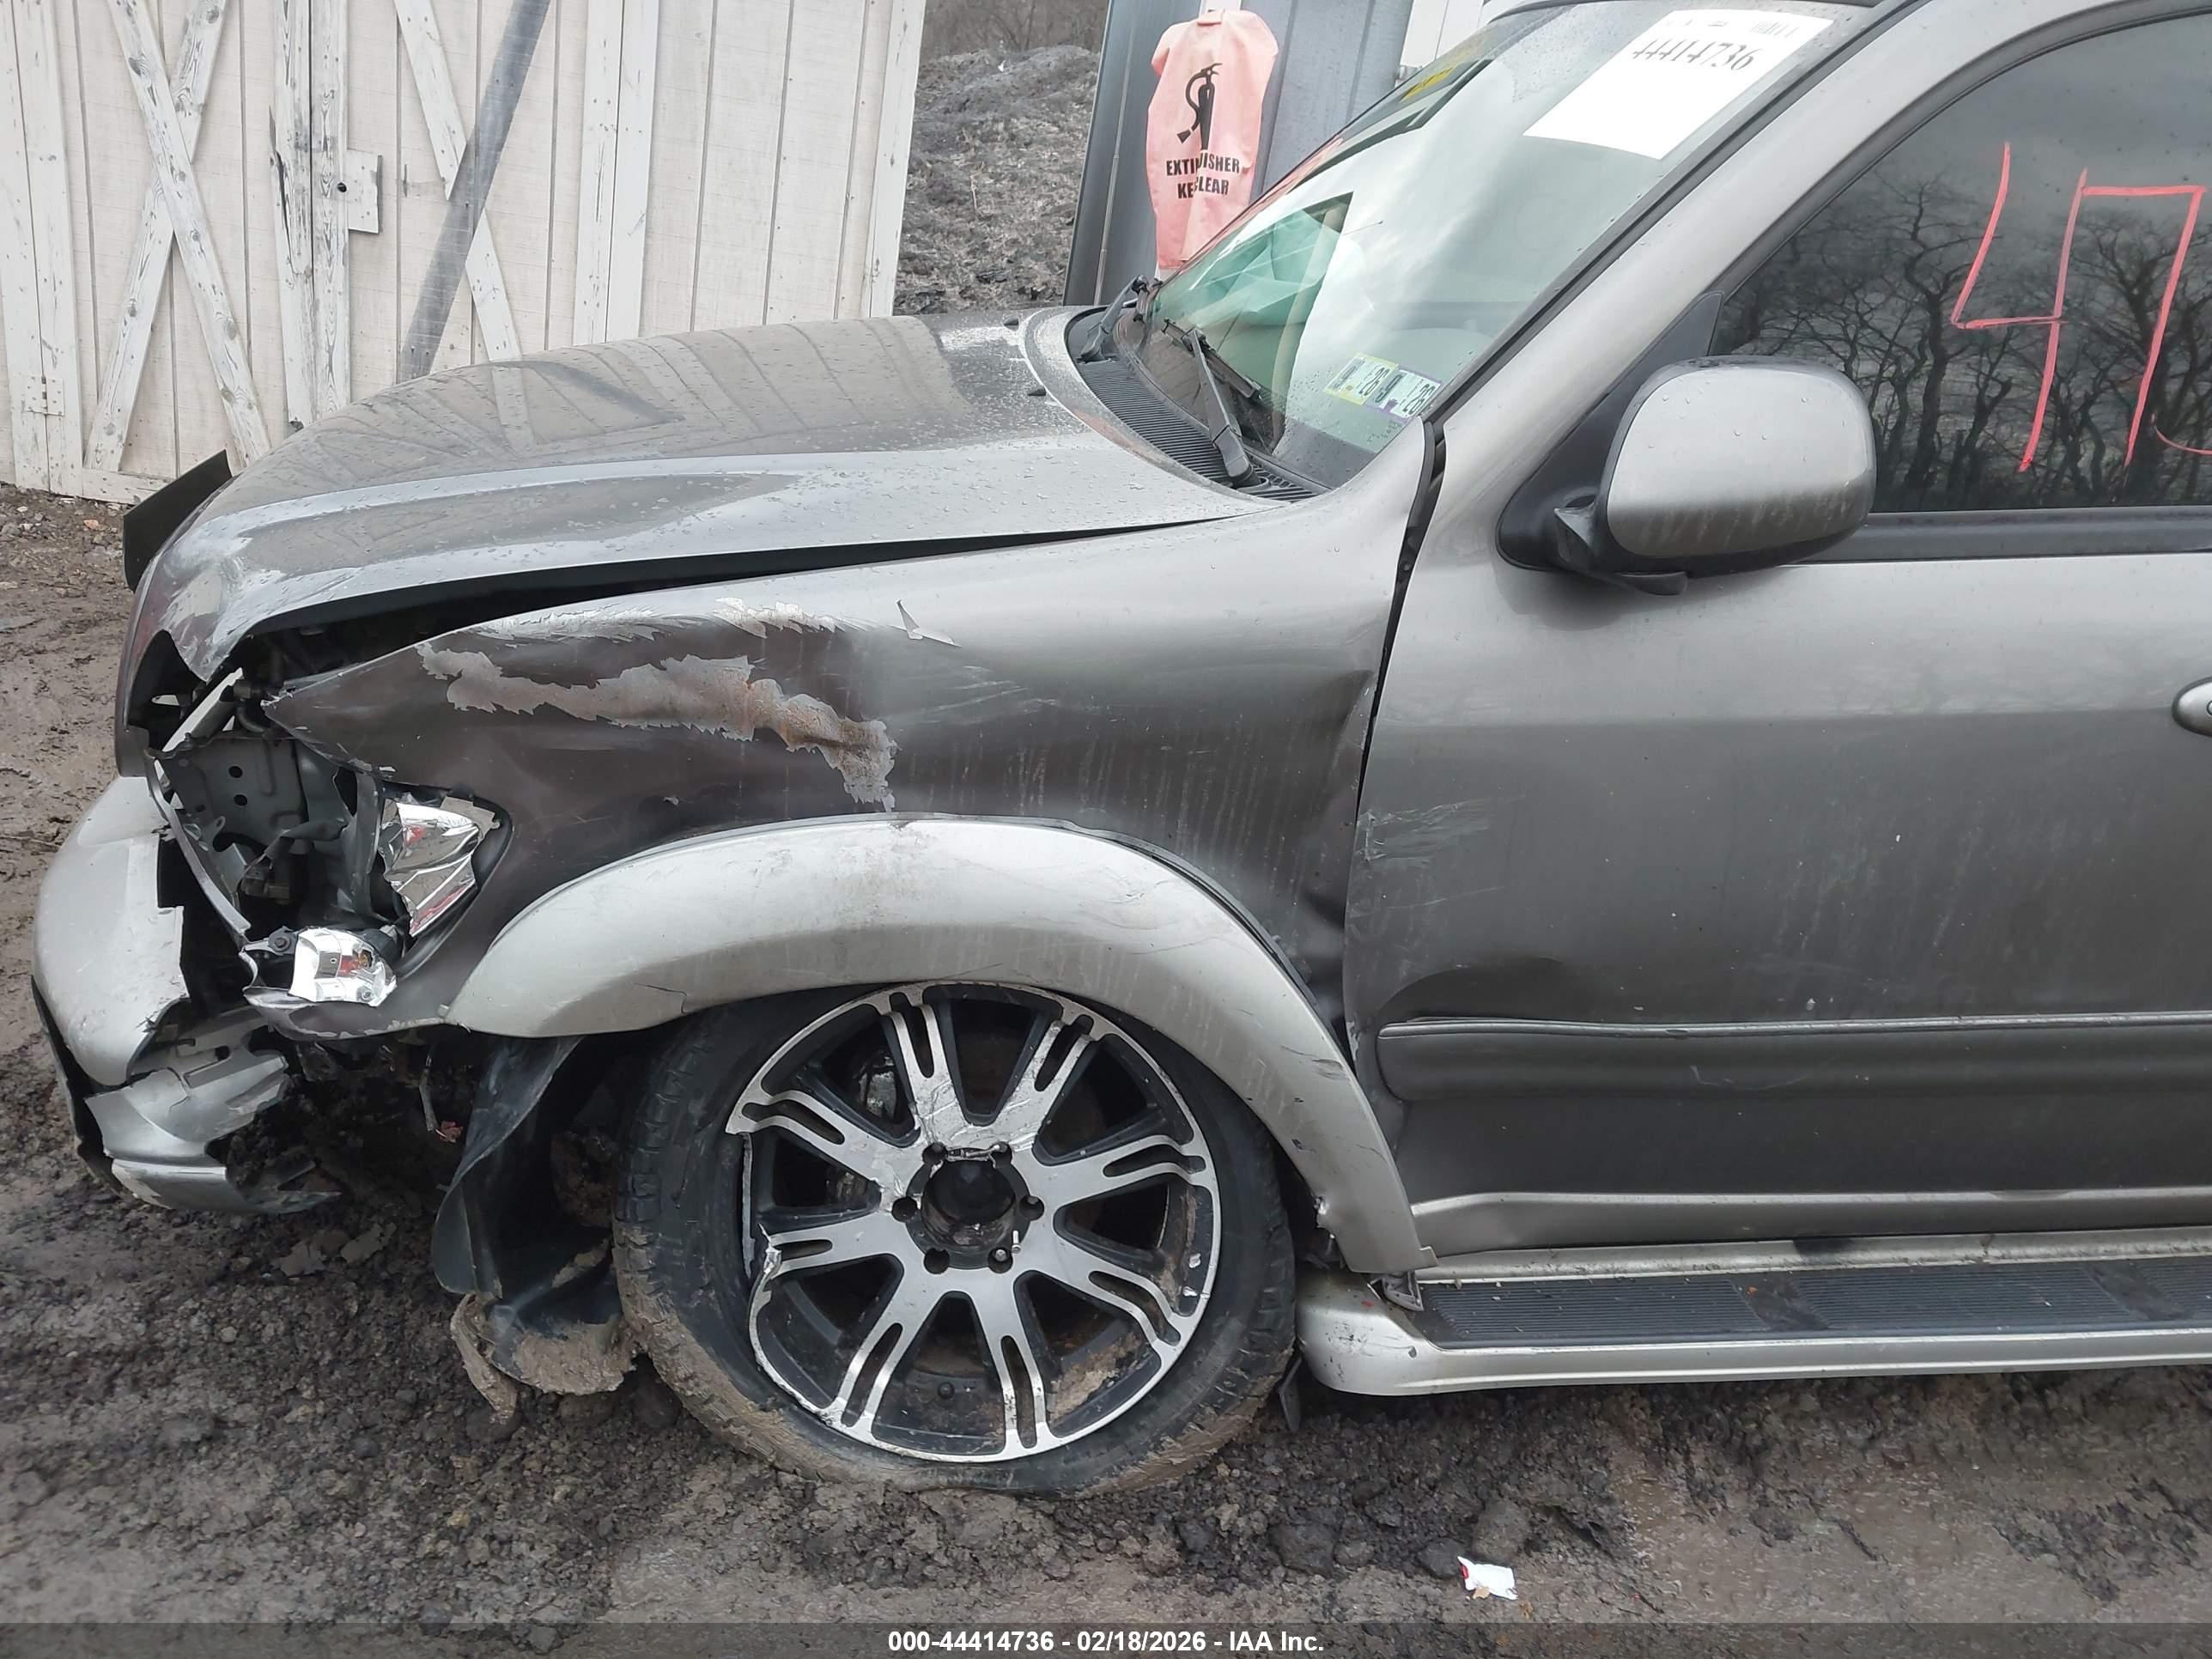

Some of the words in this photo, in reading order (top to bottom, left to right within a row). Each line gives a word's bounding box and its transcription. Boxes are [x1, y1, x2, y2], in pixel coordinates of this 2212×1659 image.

[1632, 38, 1764, 71] 44414736
[1950, 141, 2212, 477] 47
[1358, 367, 1390, 397] 26
[1402, 383, 1436, 416] 26
